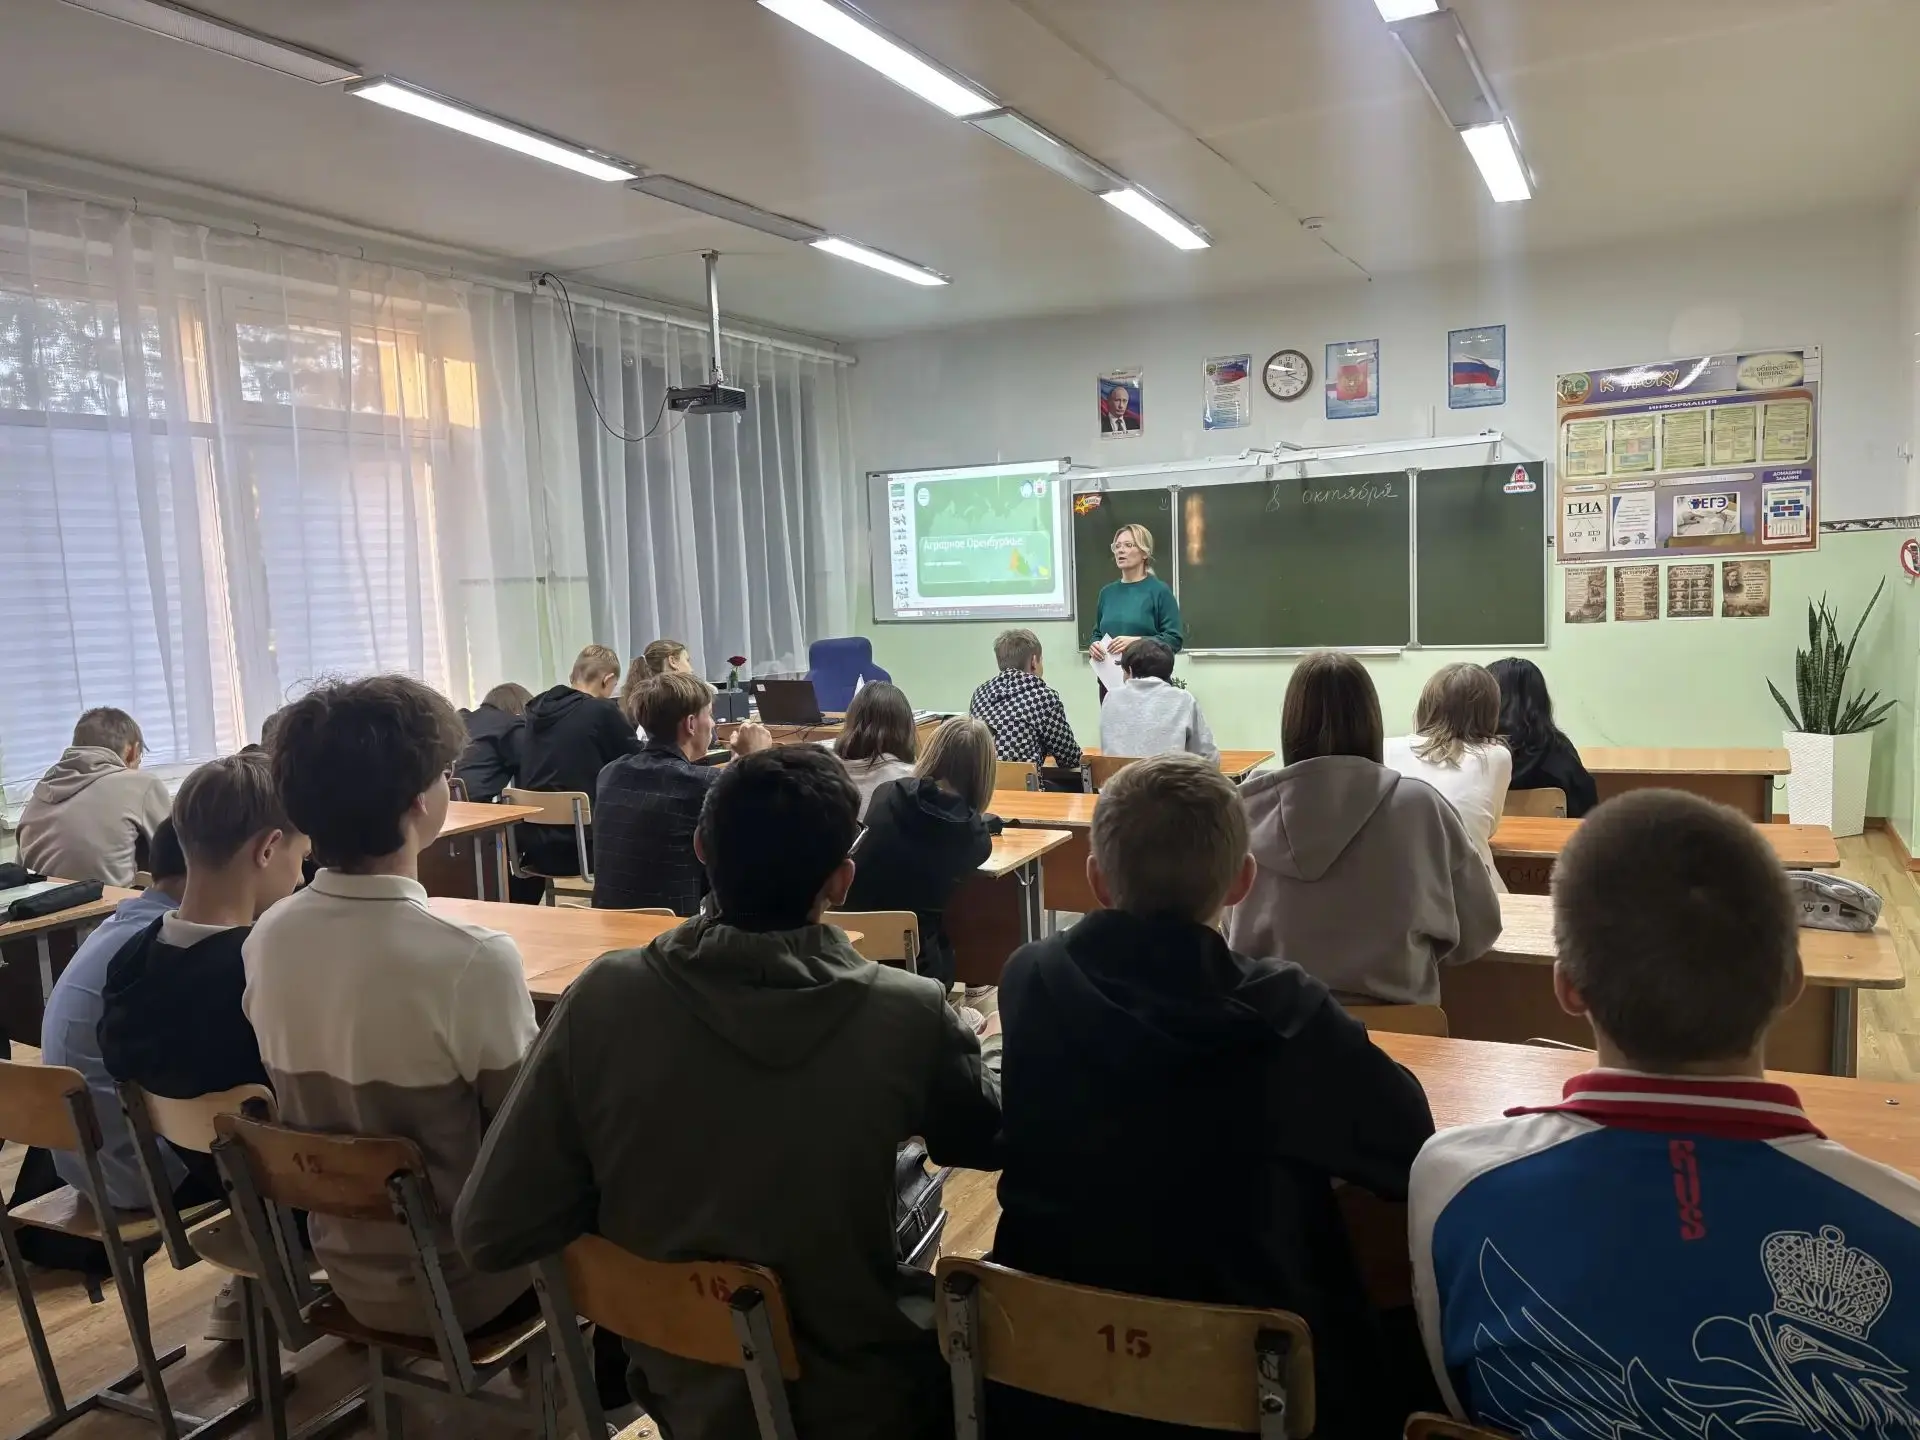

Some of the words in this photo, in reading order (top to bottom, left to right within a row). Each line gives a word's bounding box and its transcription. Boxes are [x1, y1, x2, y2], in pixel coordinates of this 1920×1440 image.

[1648, 399, 1718, 411] ИНФОРМАЦИЯ
[1265, 483, 1281, 512] 8
[1302, 480, 1399, 508] октября
[1566, 501, 1603, 514] ГИА
[1700, 496, 1727, 509] ЕГЭ
[923, 538, 966, 552] Аграрное
[1667, 1139, 1707, 1241] RUS
[689, 1271, 732, 1303] 16
[1096, 1323, 1152, 1359] 15
